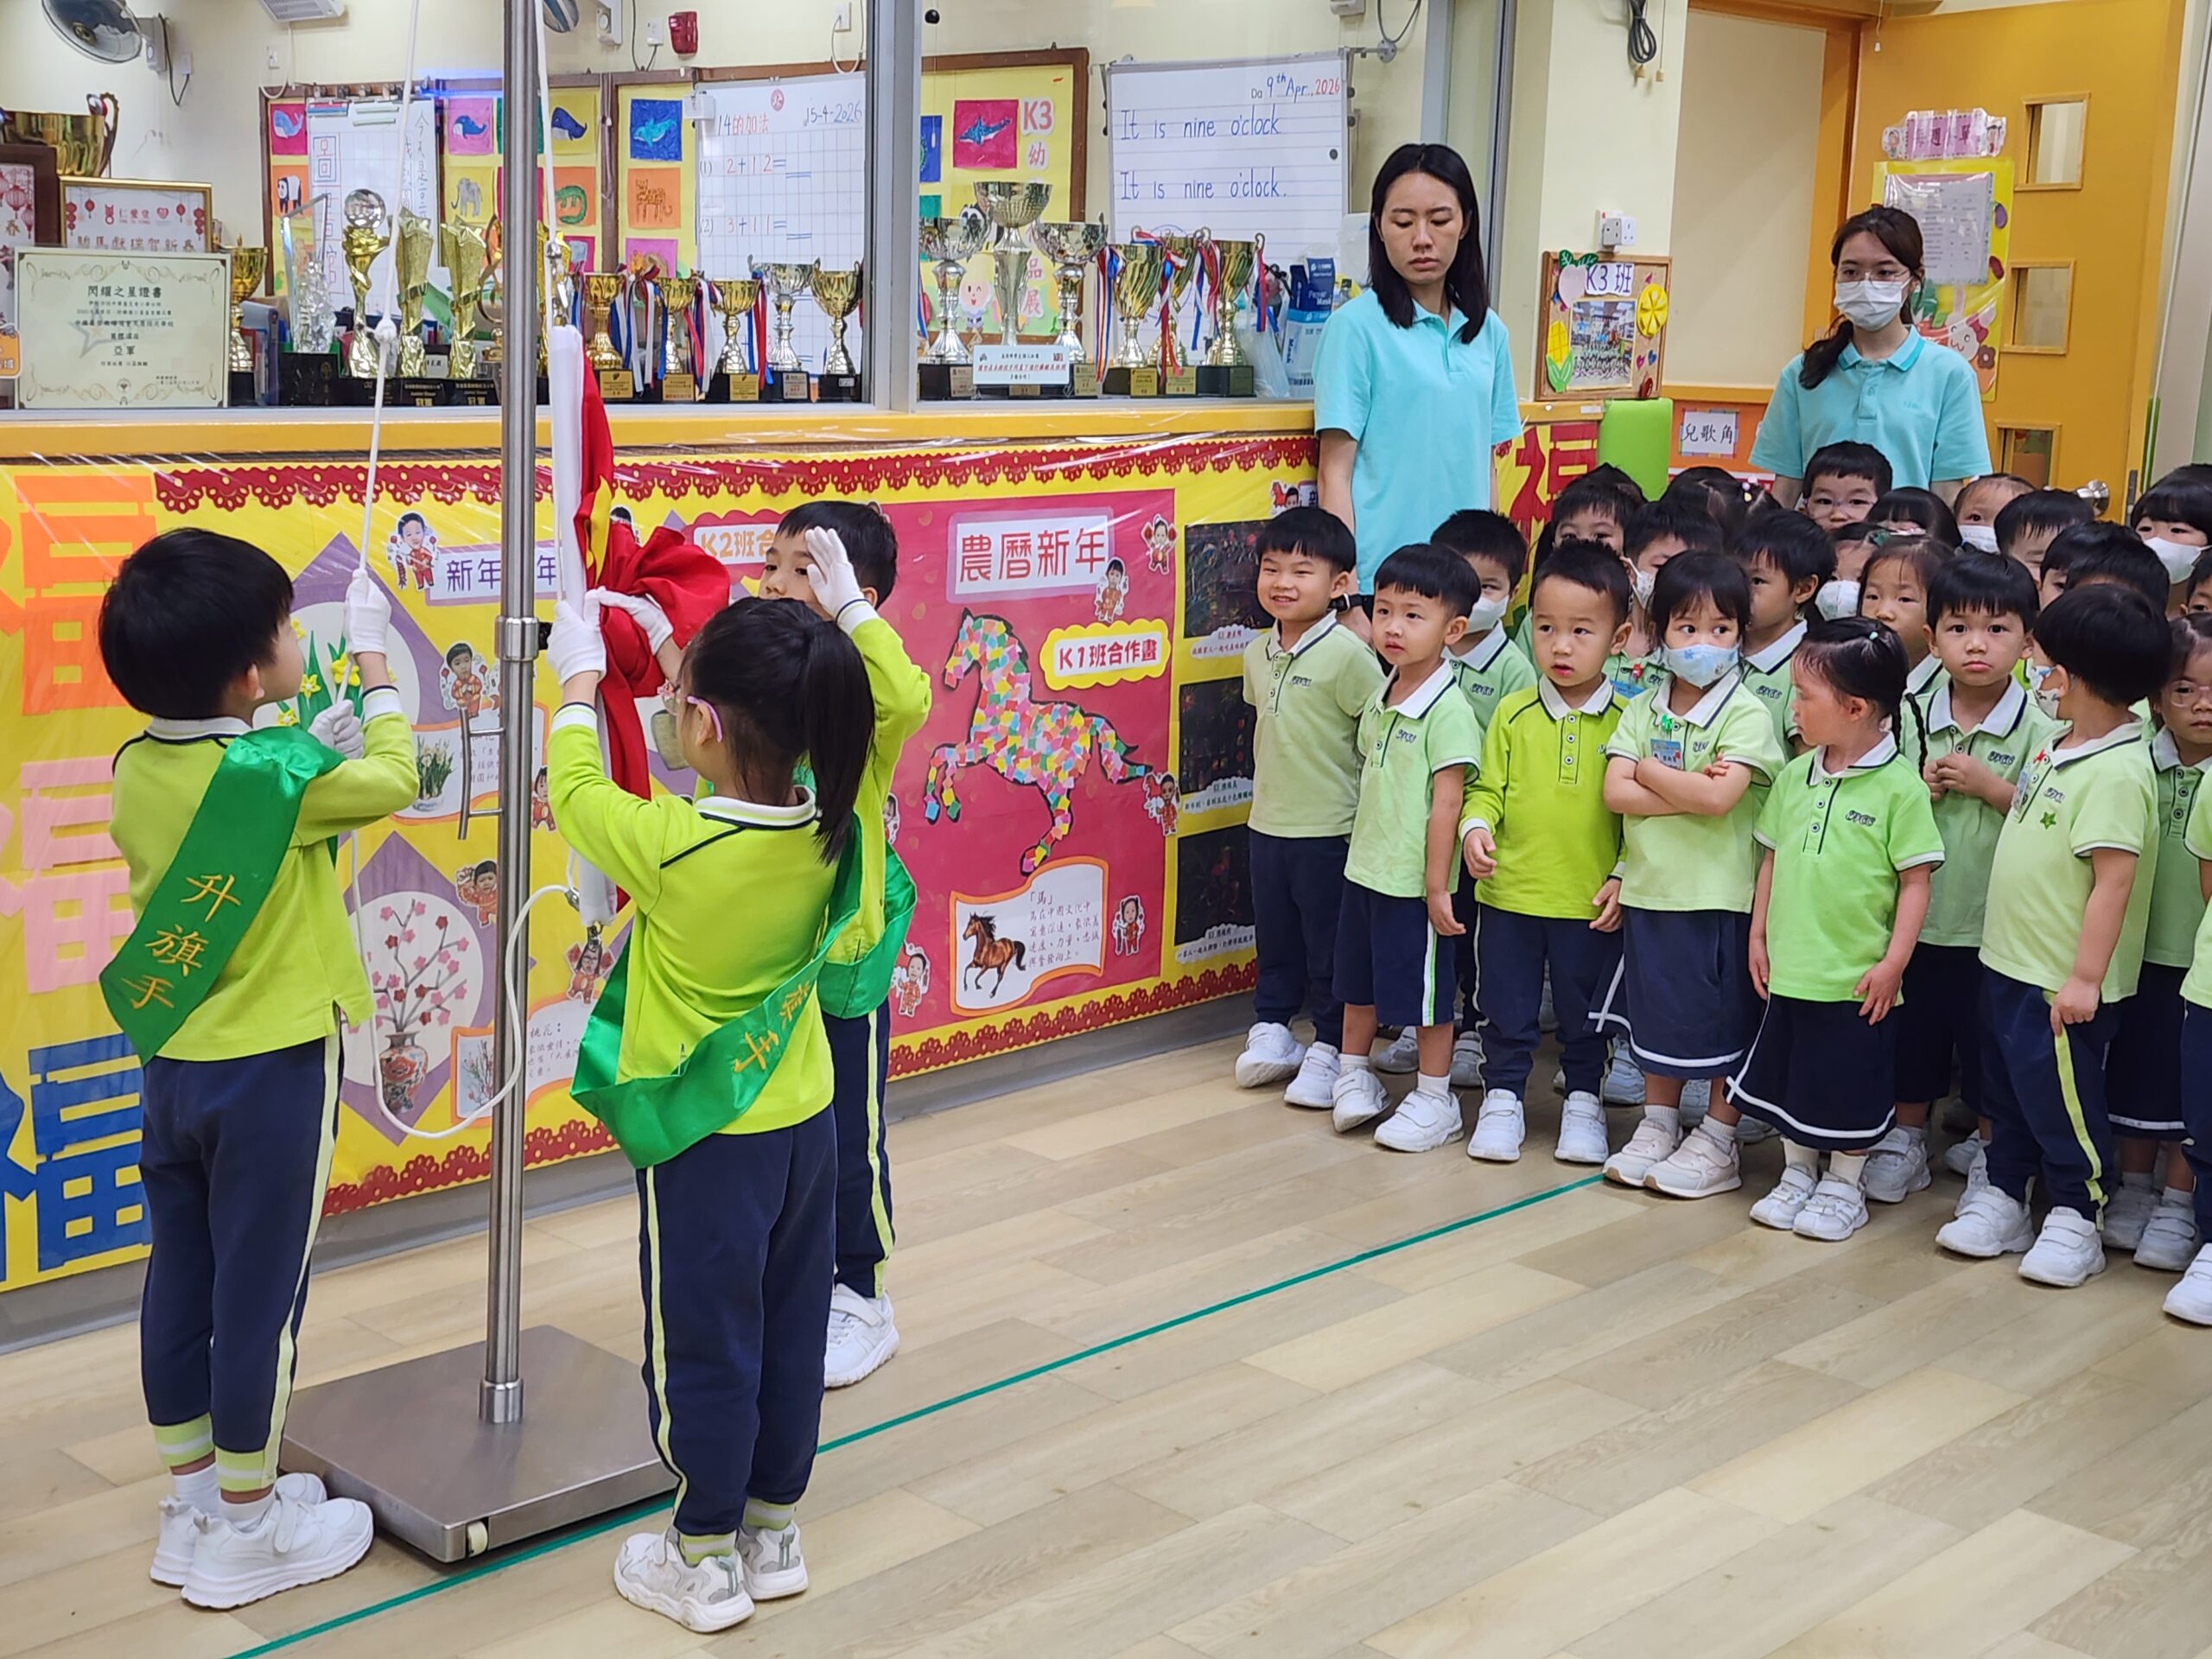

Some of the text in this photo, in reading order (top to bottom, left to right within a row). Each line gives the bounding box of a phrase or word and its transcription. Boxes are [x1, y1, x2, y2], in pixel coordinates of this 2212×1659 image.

[1315, 77, 1341, 96] 2026
[718, 112, 769, 137] 14的加法
[1023, 99, 1052, 130] K3
[1121, 110, 1139, 140] It
[1154, 119, 1166, 139] is
[1184, 117, 1216, 138] nine
[1121, 170, 1139, 200] It
[1154, 181, 1165, 200] is
[1184, 179, 1214, 199] nine
[87, 285, 162, 298] 閃耀之星證書
[1586, 262, 1633, 293] K3 班
[113, 345, 136, 356] 亞軍
[1683, 423, 1733, 445] 兒歌角
[959, 528, 1108, 584] 農曆新年
[1058, 639, 1158, 671] K1班合作畫
[120, 873, 242, 1011] 升旗手
